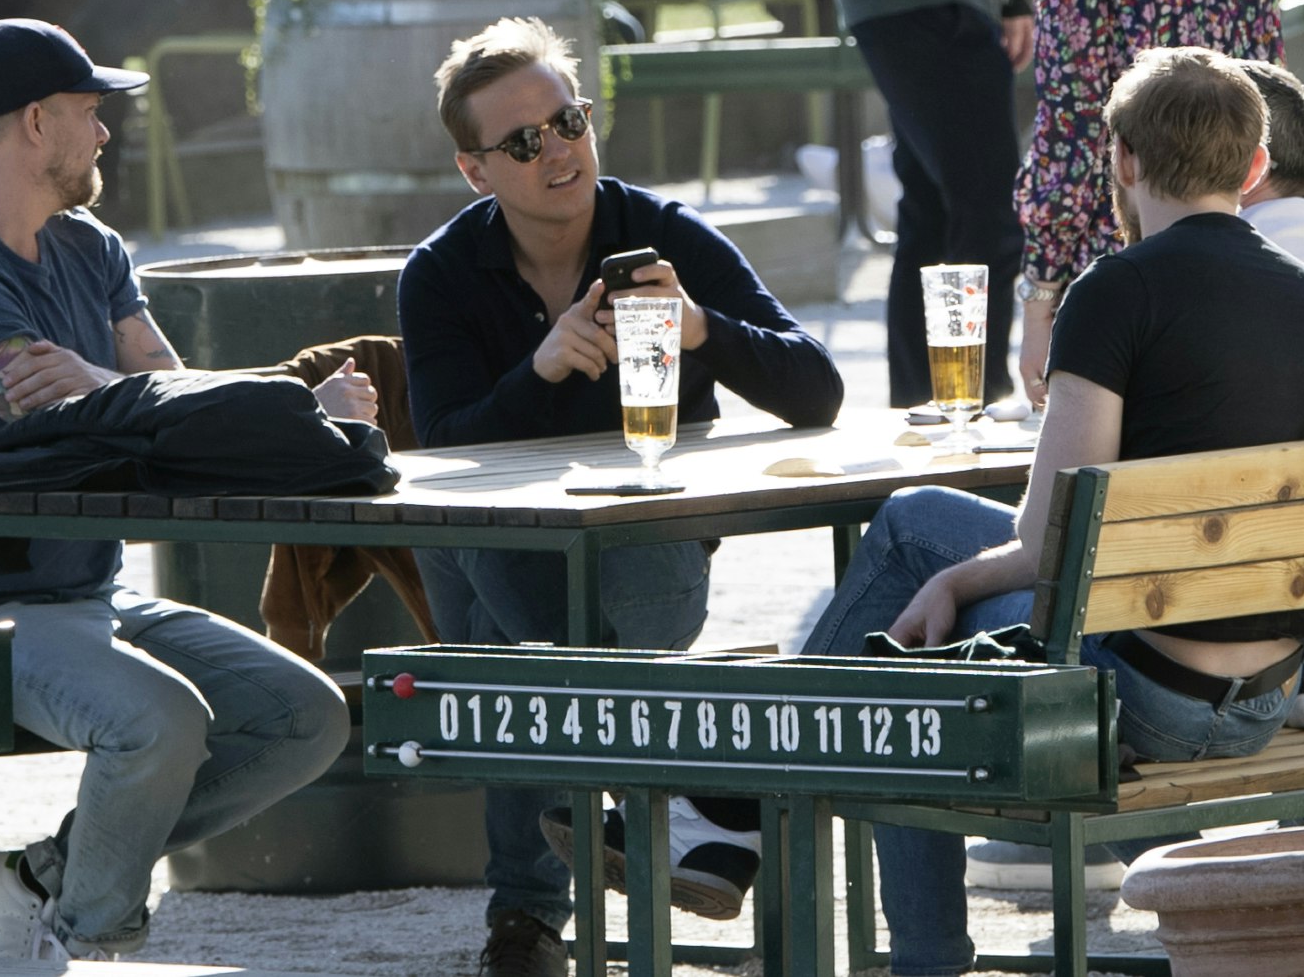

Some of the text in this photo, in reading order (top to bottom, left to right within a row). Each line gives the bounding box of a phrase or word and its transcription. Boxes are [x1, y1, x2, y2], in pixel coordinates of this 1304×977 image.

[440, 693, 941, 757] 0 1 2 3 4 5 6 7 8 9 10 11 12 13
